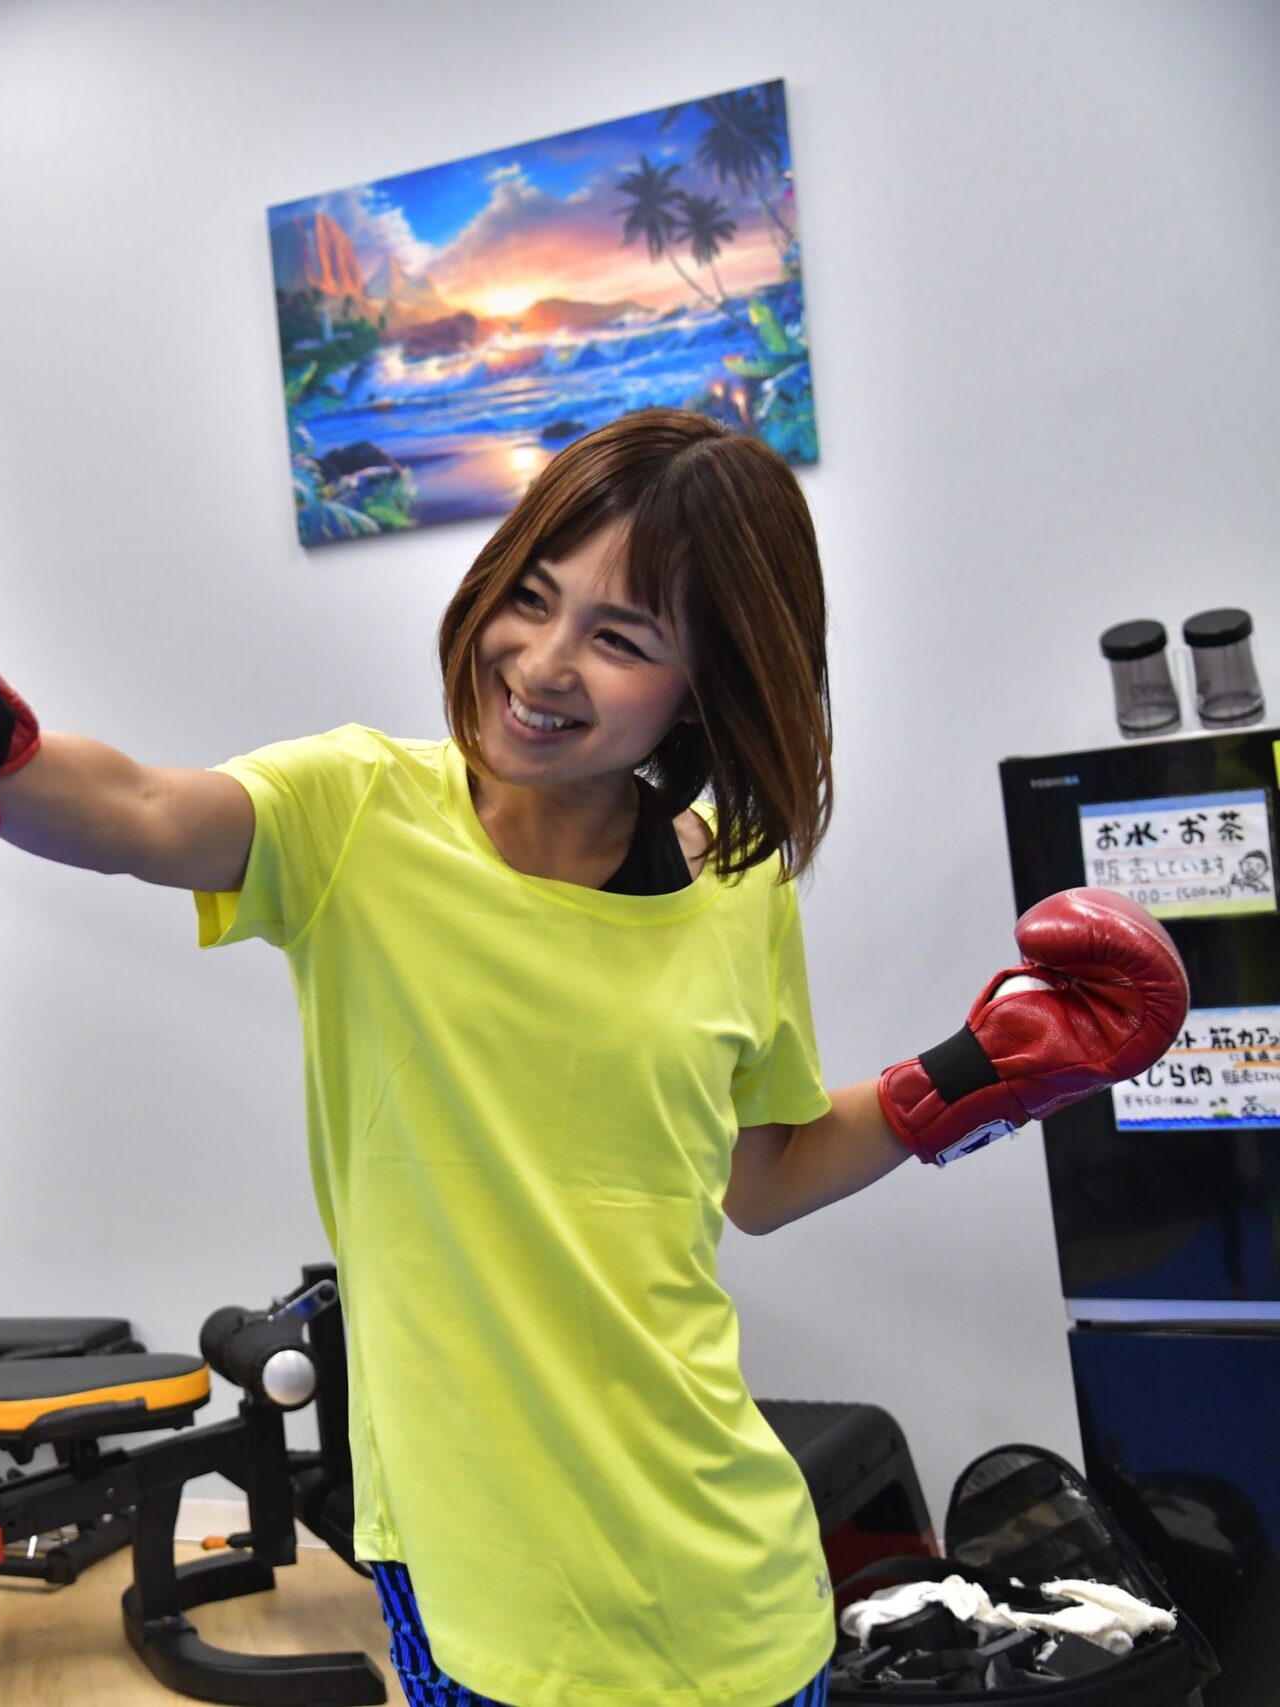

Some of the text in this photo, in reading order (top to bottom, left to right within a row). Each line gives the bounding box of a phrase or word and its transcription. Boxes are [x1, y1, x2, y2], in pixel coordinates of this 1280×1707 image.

[1096, 810, 1245, 850] お水・お茶
[1093, 856, 1225, 885] 販売しています
